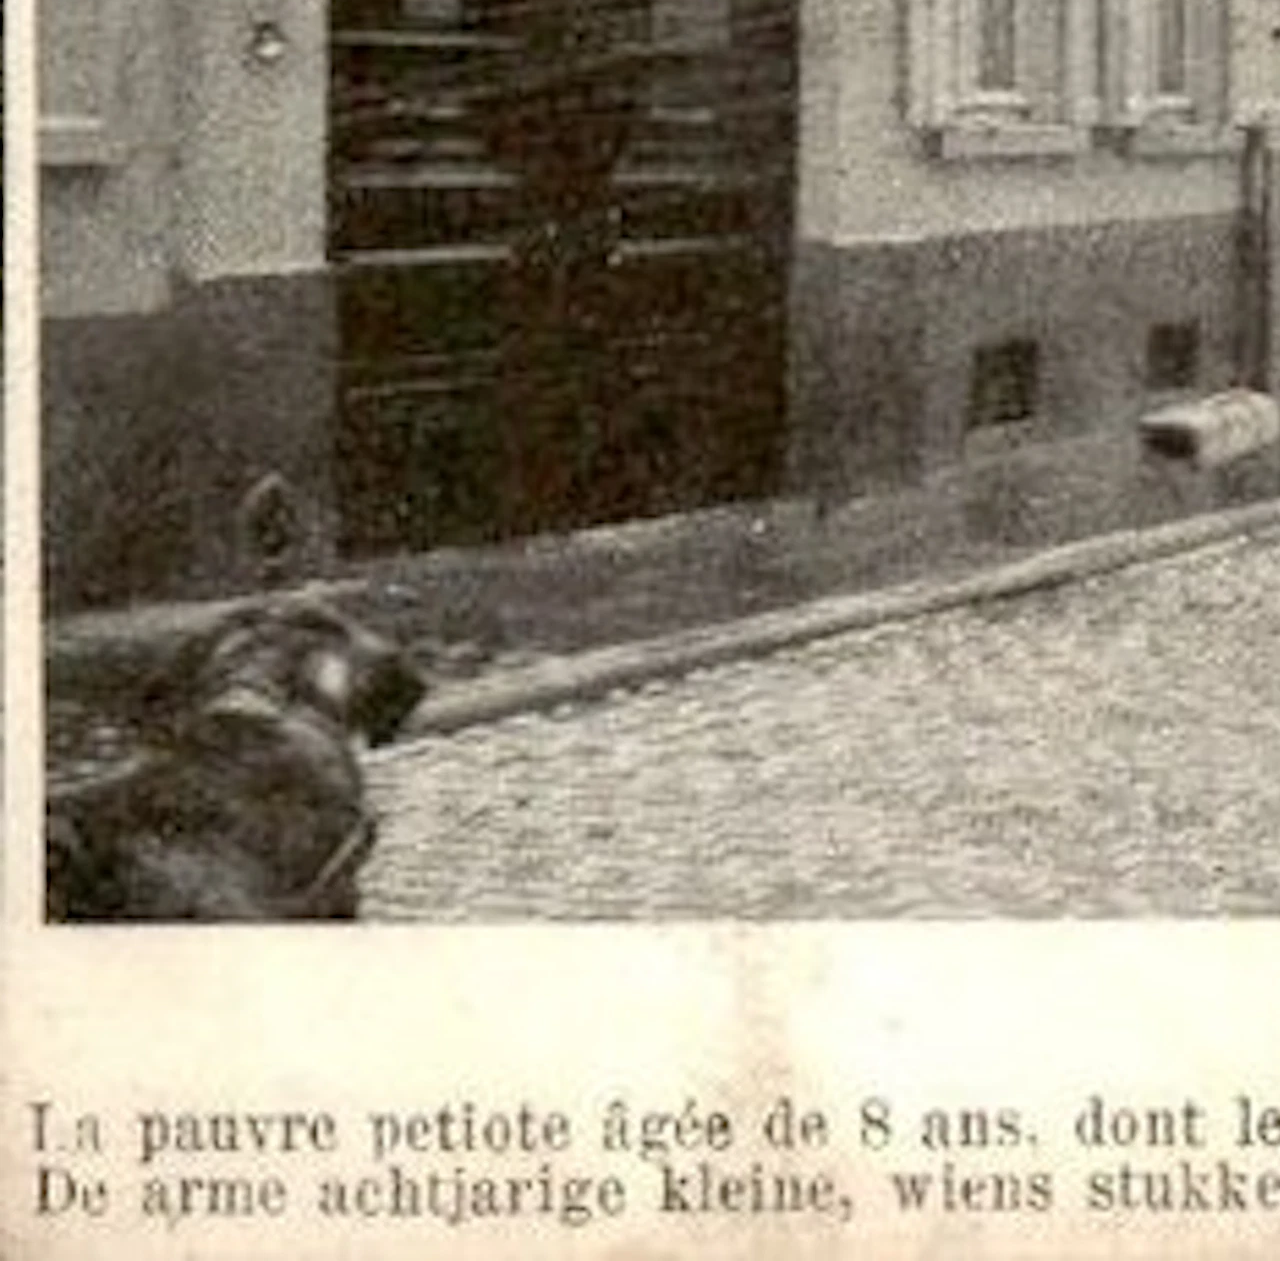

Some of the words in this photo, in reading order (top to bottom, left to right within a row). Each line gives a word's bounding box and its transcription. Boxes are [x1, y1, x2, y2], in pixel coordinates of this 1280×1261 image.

[138, 1109, 336, 1162] pauvre
[370, 1103, 571, 1160] petiote
[602, 1100, 731, 1162] âgée
[762, 1097, 827, 1150] de
[858, 1097, 893, 1149] 8
[1074, 1095, 1208, 1148] dont
[35, 1166, 108, 1217] De
[142, 1176, 288, 1218] arme
[318, 1165, 627, 1227] achtjarige
[660, 1164, 853, 1222] kleine,
[893, 1164, 1054, 1214] wiens
